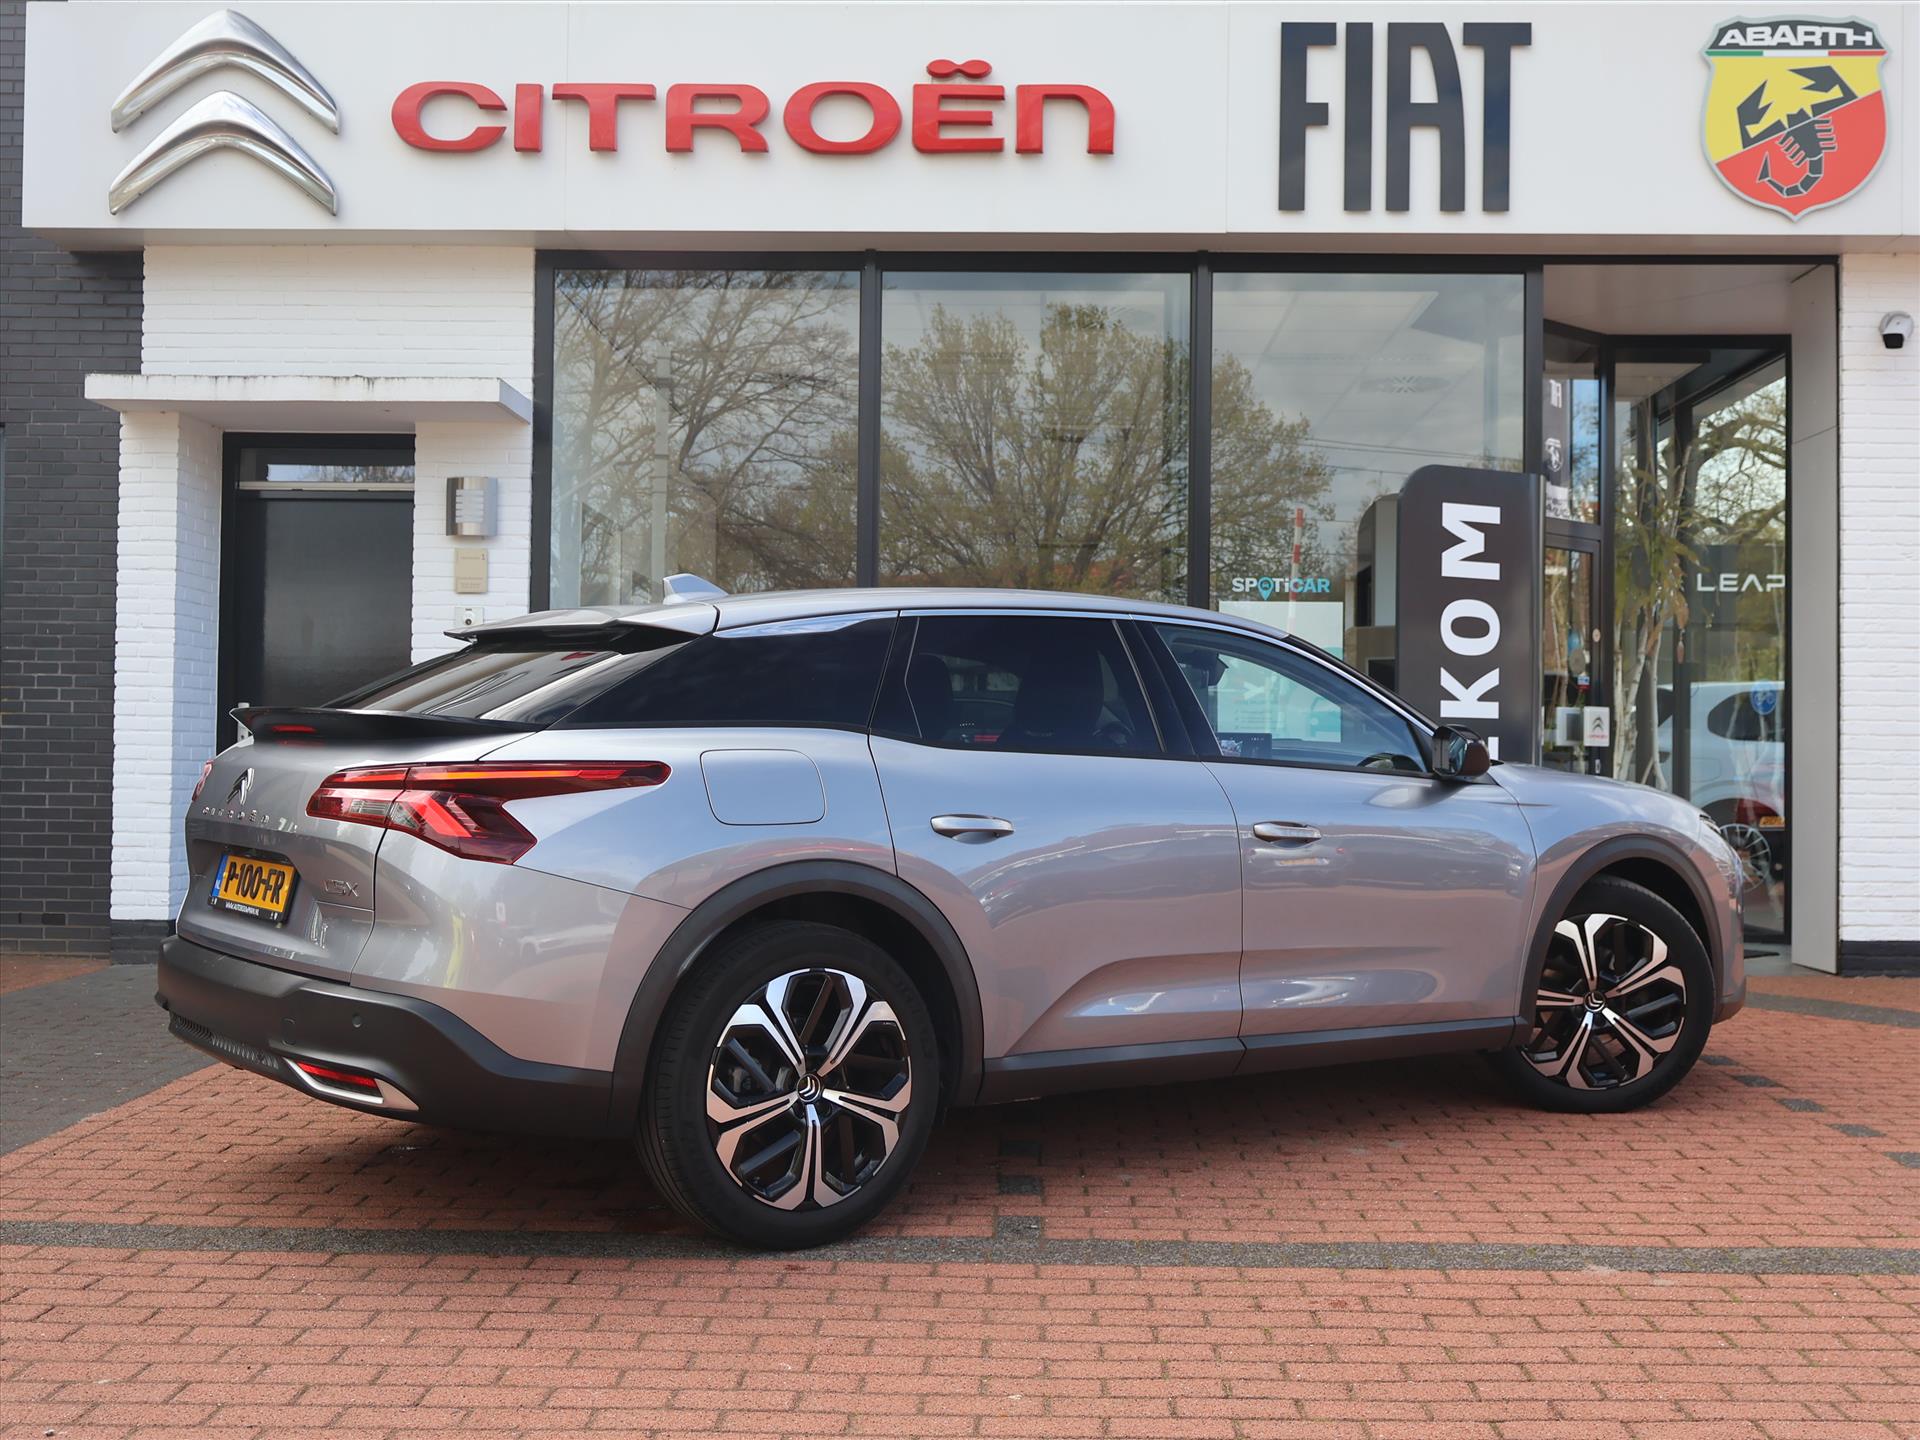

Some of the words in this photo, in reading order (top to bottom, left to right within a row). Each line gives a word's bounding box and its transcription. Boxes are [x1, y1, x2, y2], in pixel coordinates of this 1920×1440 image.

[1718, 25, 1873, 46] ABARTH
[391, 58, 1117, 155] CITROËN
[1278, 22, 1532, 212] FIAT
[1231, 577, 1330, 600] SPOTiCAR
[1696, 573, 1785, 592] LEAP
[223, 861, 286, 905] P-100-FR
